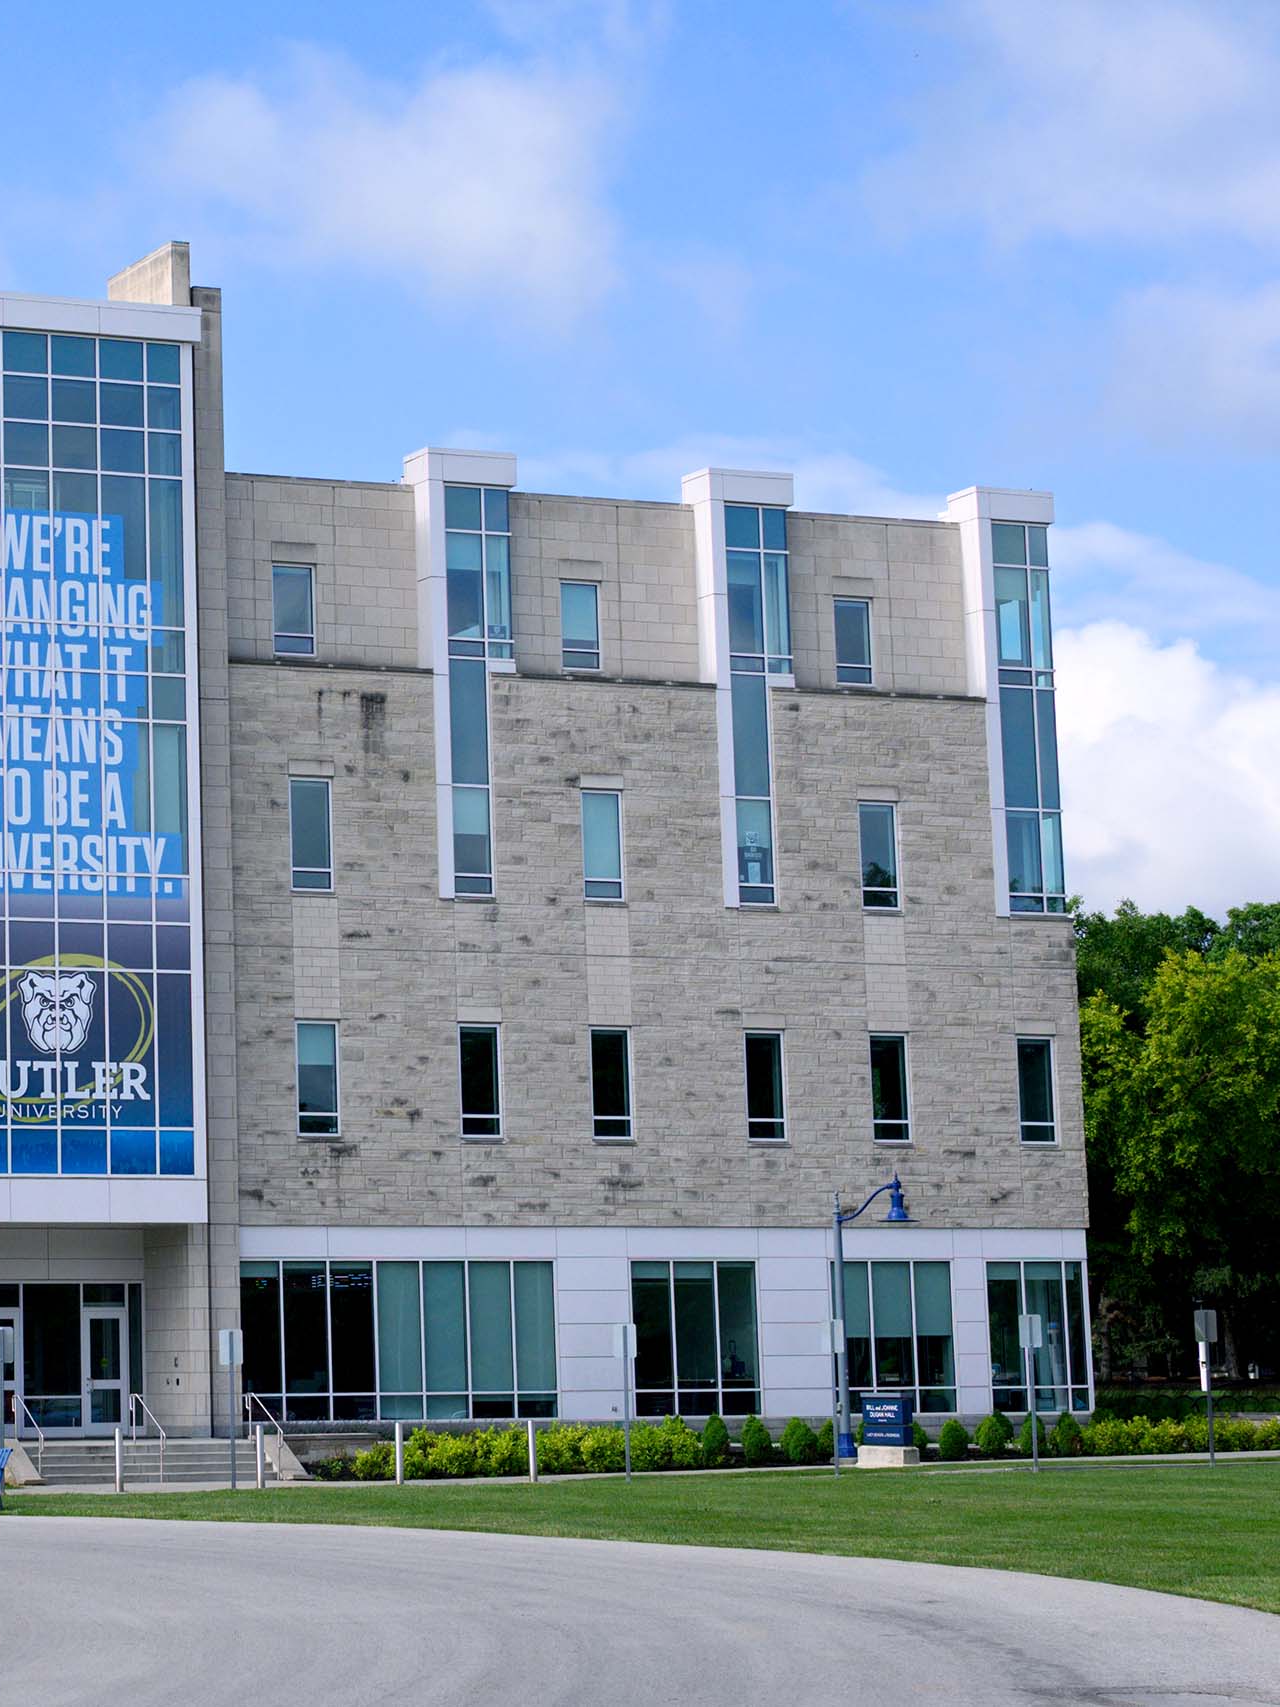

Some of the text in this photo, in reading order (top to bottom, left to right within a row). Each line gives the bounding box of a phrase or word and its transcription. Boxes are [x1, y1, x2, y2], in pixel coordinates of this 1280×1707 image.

[100, 645, 132, 702] IT
[43, 769, 90, 828] BE
[104, 772, 126, 829] A
